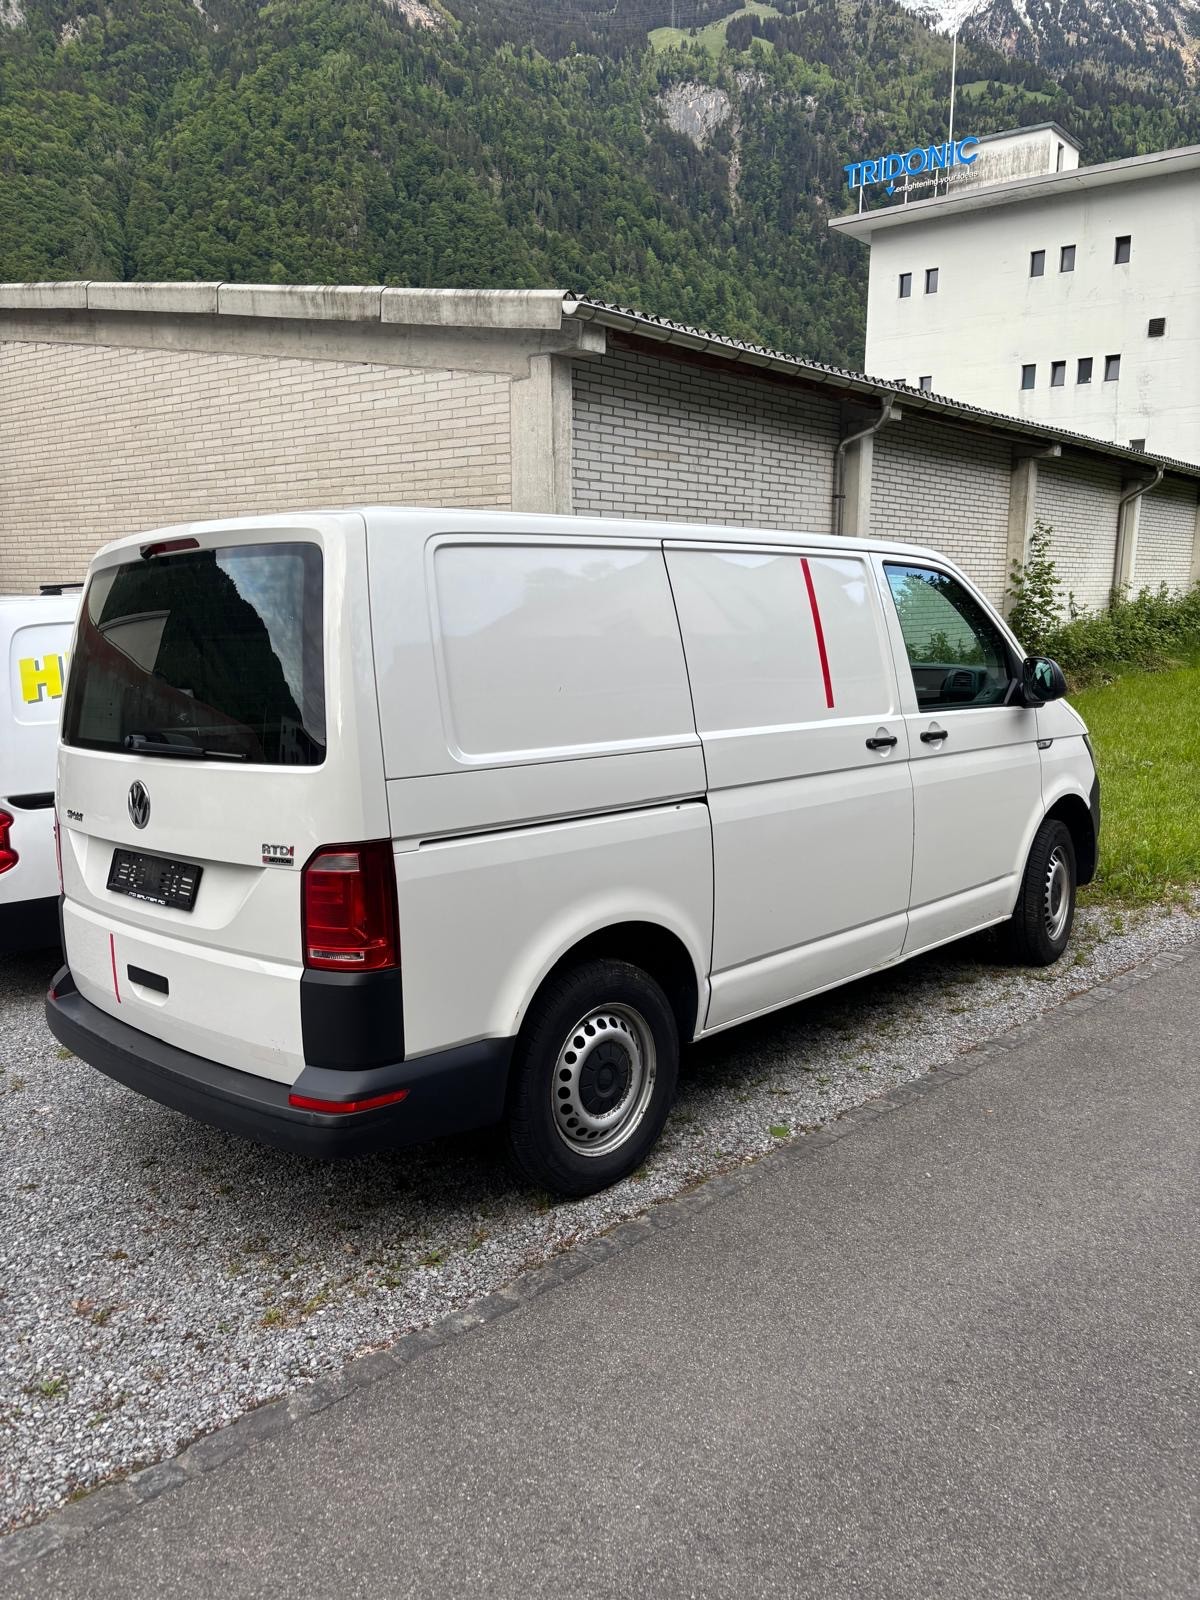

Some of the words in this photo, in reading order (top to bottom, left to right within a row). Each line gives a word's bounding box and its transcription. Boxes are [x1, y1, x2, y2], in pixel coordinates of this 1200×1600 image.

[844, 136, 980, 189] TRIDONIC
[896, 178, 938, 193] enlightening
[940, 175, 956, 185] your
